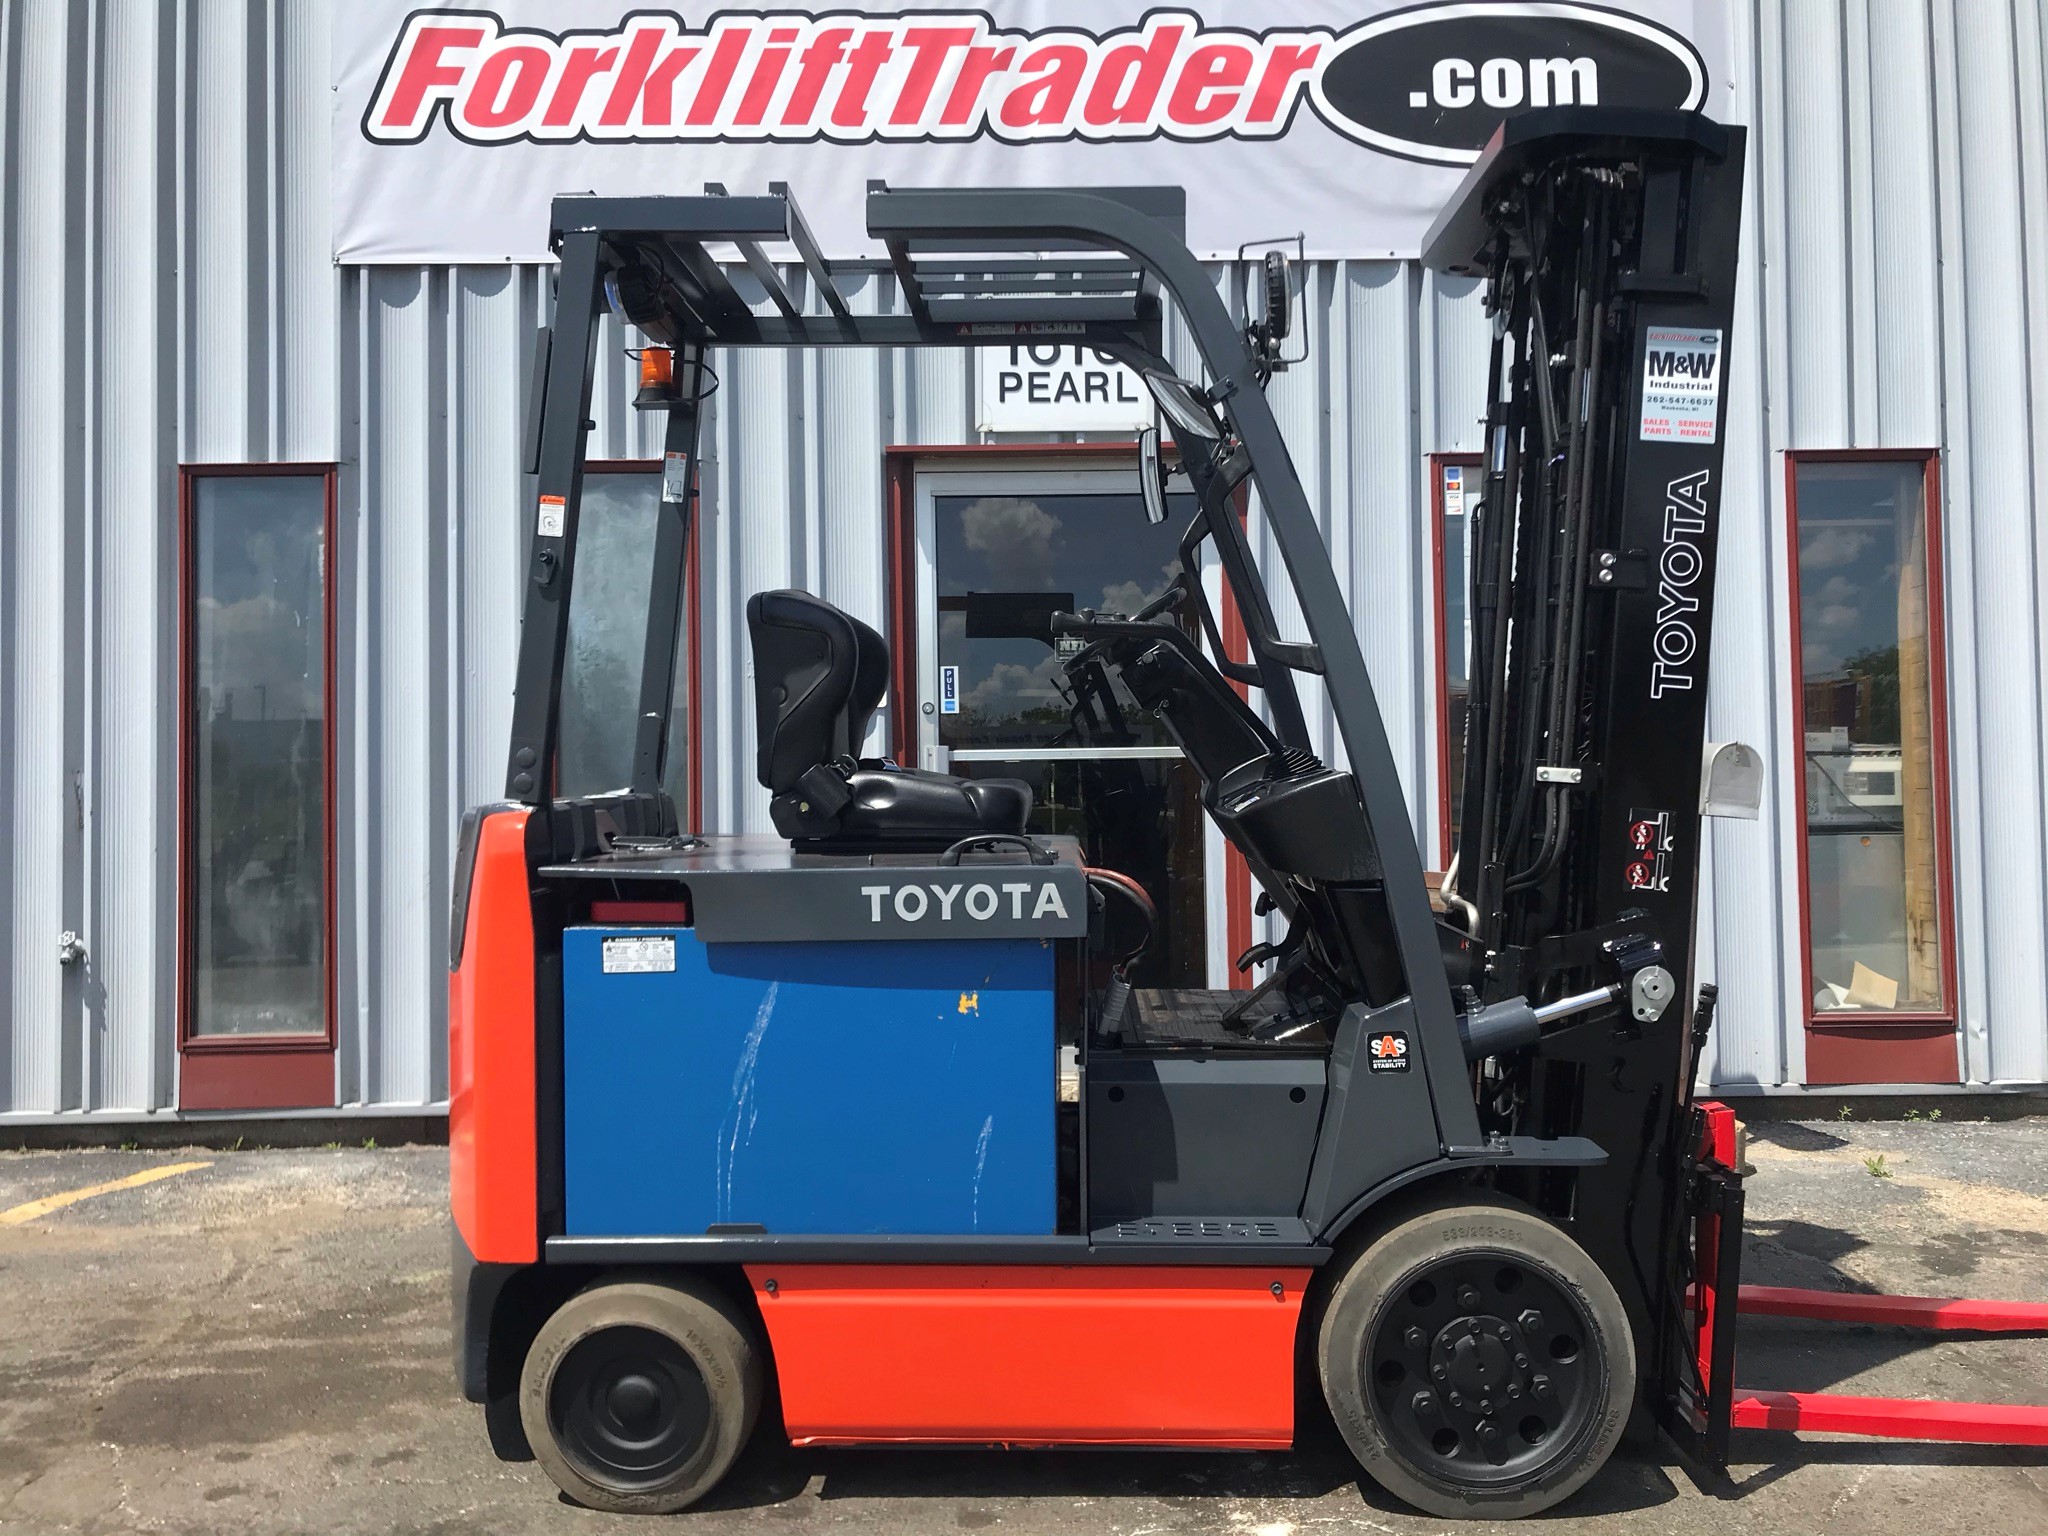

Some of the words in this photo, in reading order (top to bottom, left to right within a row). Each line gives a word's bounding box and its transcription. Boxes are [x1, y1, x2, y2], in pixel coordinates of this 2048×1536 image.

[378, 22, 1324, 130] ForkliftTrader
[1648, 350, 1717, 379] M&W
[999, 371, 1139, 403] PEARL
[1649, 380, 1713, 391] Industrial
[1646, 396, 1714, 406] 262-547-6637
[1643, 418, 1670, 426] SALES
[1678, 420, 1714, 428] SERVICE
[1644, 427, 1672, 435] PARTS
[1680, 429, 1712, 437] RENTAL
[1651, 469, 1710, 699] TOYOTA
[1059, 640, 1086, 651] NFI
[861, 883, 1069, 922] TOYOTA
[1371, 1036, 1407, 1058] SAS
